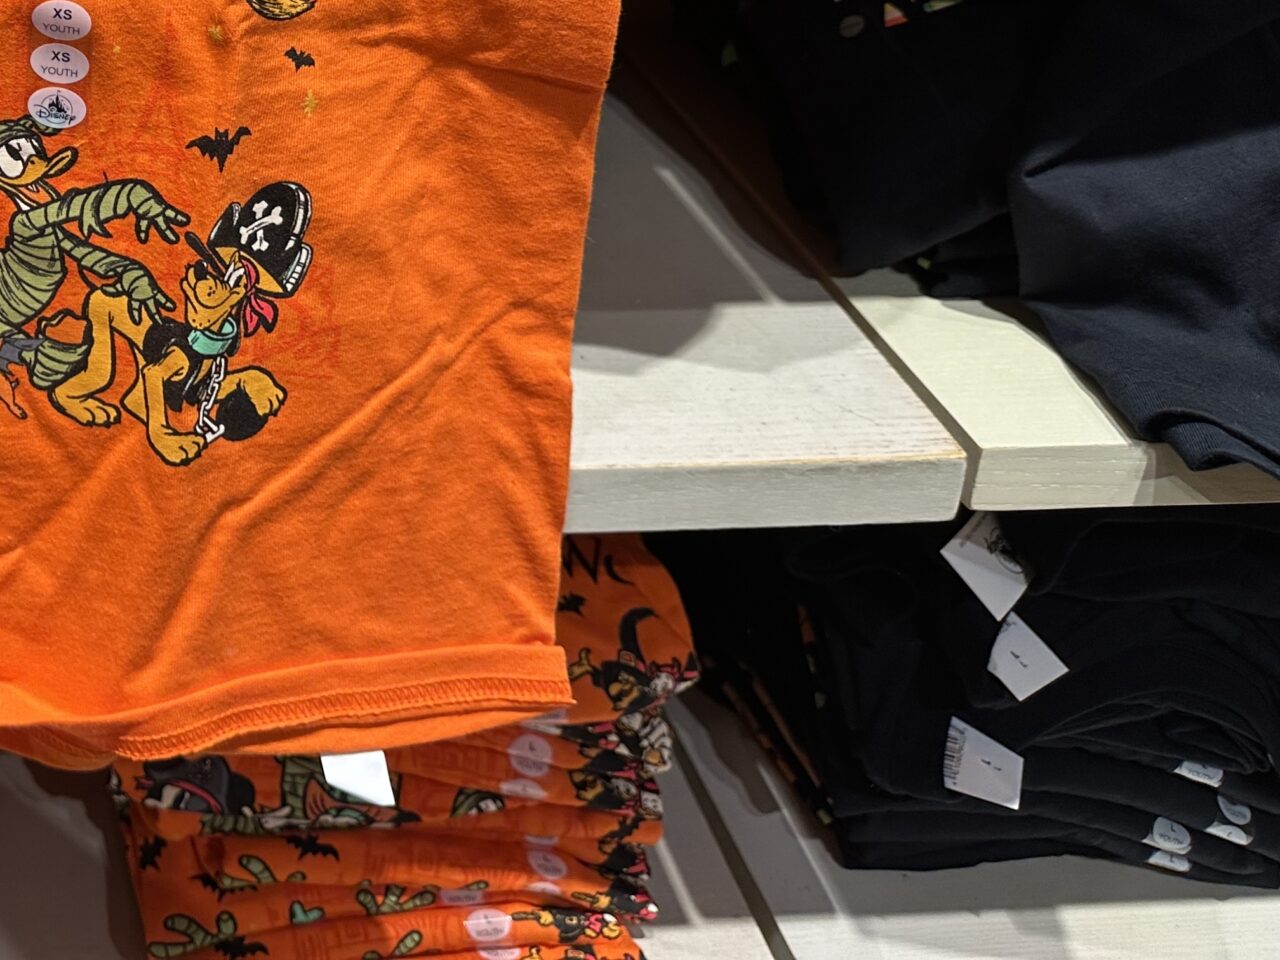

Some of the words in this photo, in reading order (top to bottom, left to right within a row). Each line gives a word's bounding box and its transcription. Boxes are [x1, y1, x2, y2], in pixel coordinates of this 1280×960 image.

[52, 7, 73, 20] XS
[42, 22, 81, 36] YOUTH
[50, 50, 71, 63] XS
[40, 65, 79, 78] YOUTH
